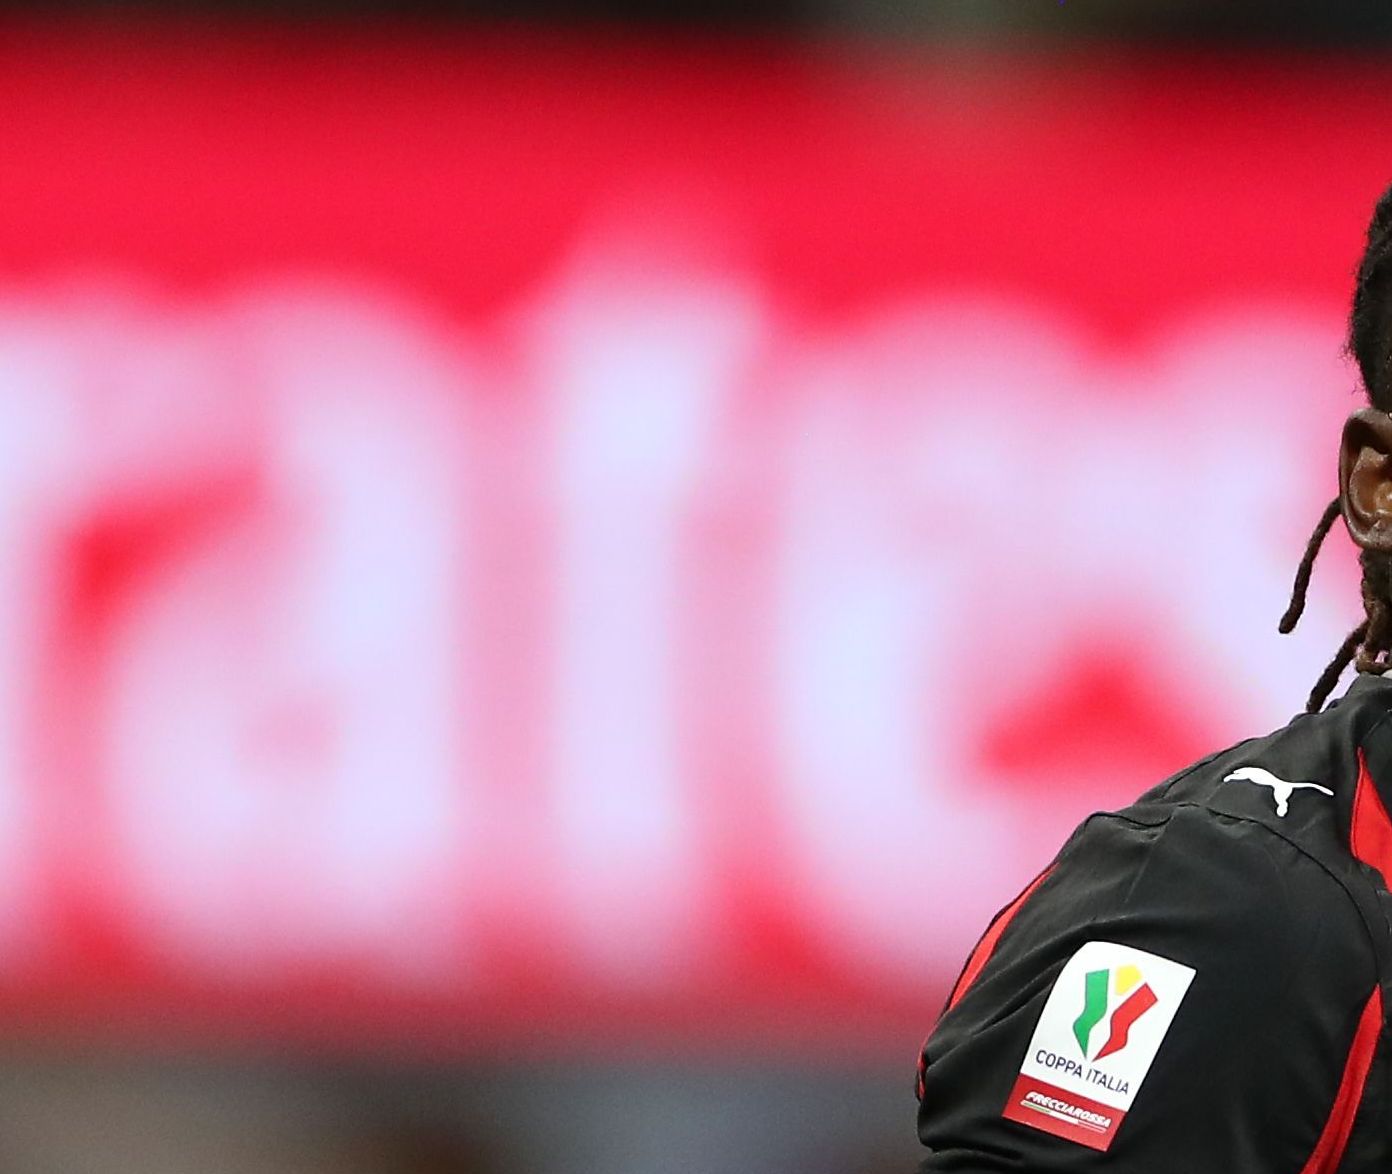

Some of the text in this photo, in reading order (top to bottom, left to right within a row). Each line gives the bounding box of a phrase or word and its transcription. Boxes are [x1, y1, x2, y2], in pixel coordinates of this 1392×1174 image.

[1035, 1048, 1130, 1095] COPPA ITALIA
[1025, 1091, 1111, 1127] FRECCIAROSSA
